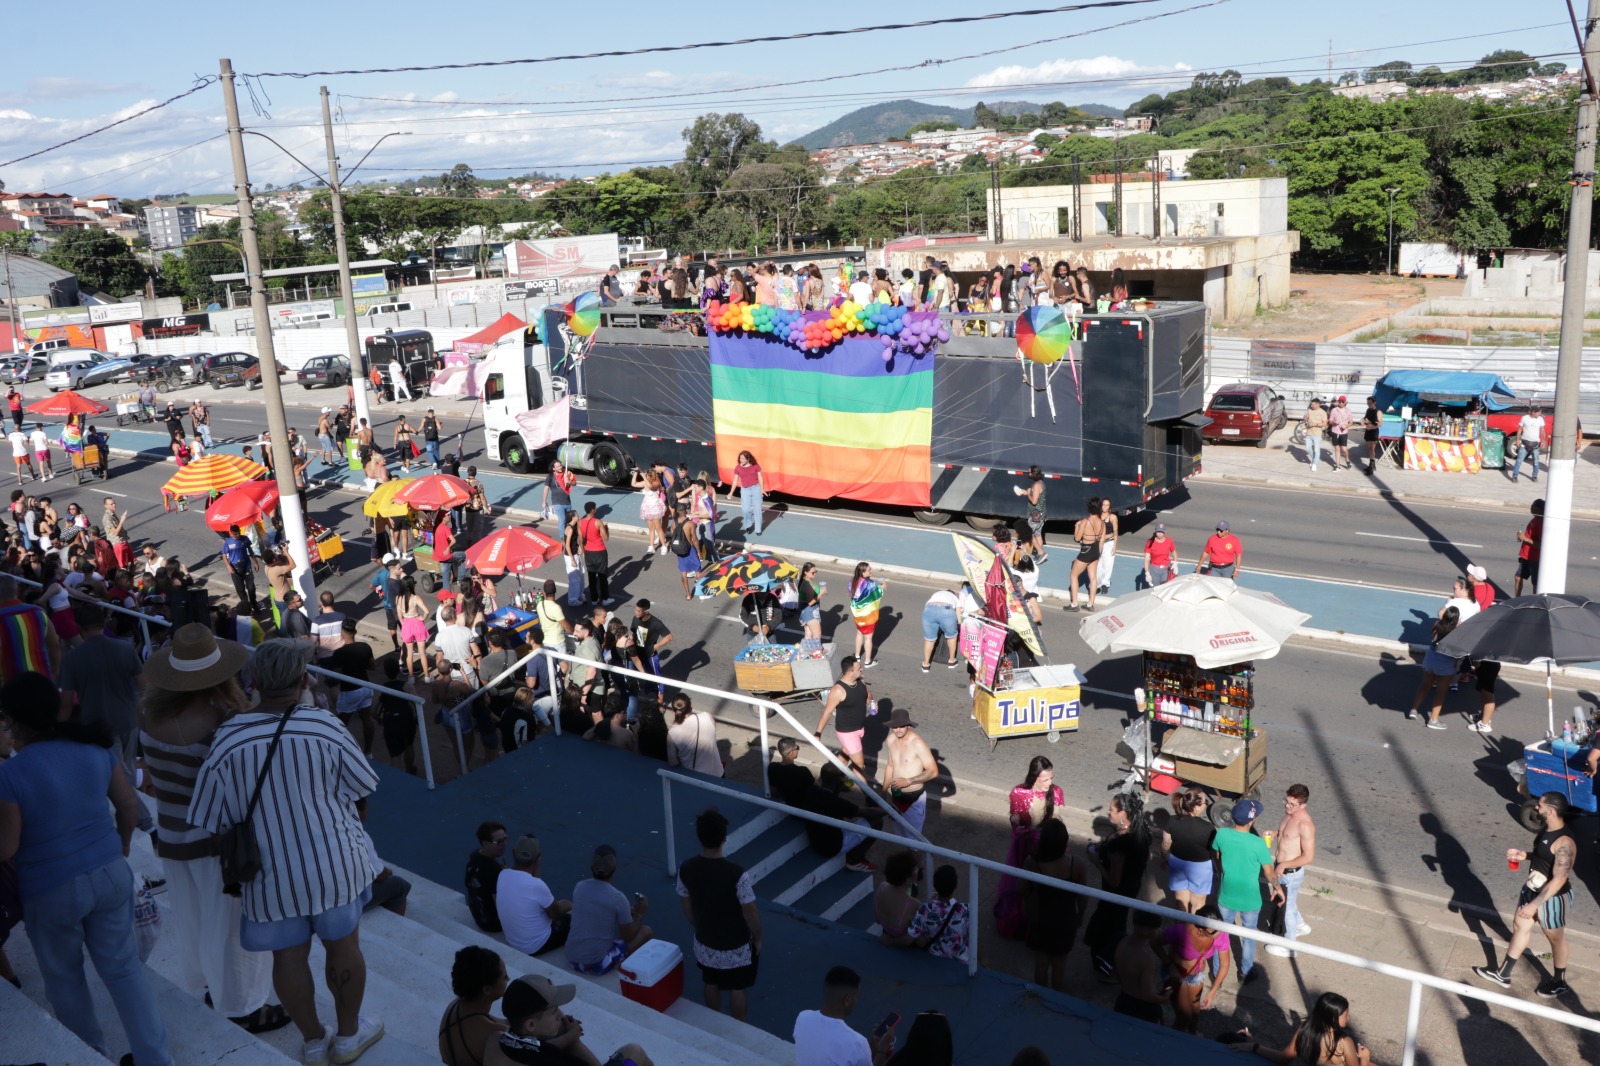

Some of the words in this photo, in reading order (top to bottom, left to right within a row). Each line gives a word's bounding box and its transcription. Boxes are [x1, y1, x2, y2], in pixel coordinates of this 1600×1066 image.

[555, 247, 579, 260] SM
[162, 317, 186, 328] MG
[1264, 360, 1295, 370] NANCI
[488, 537, 506, 562] BRAHMA
[1209, 636, 1257, 649] ORIGINAL
[997, 698, 1080, 730] Tulipa
